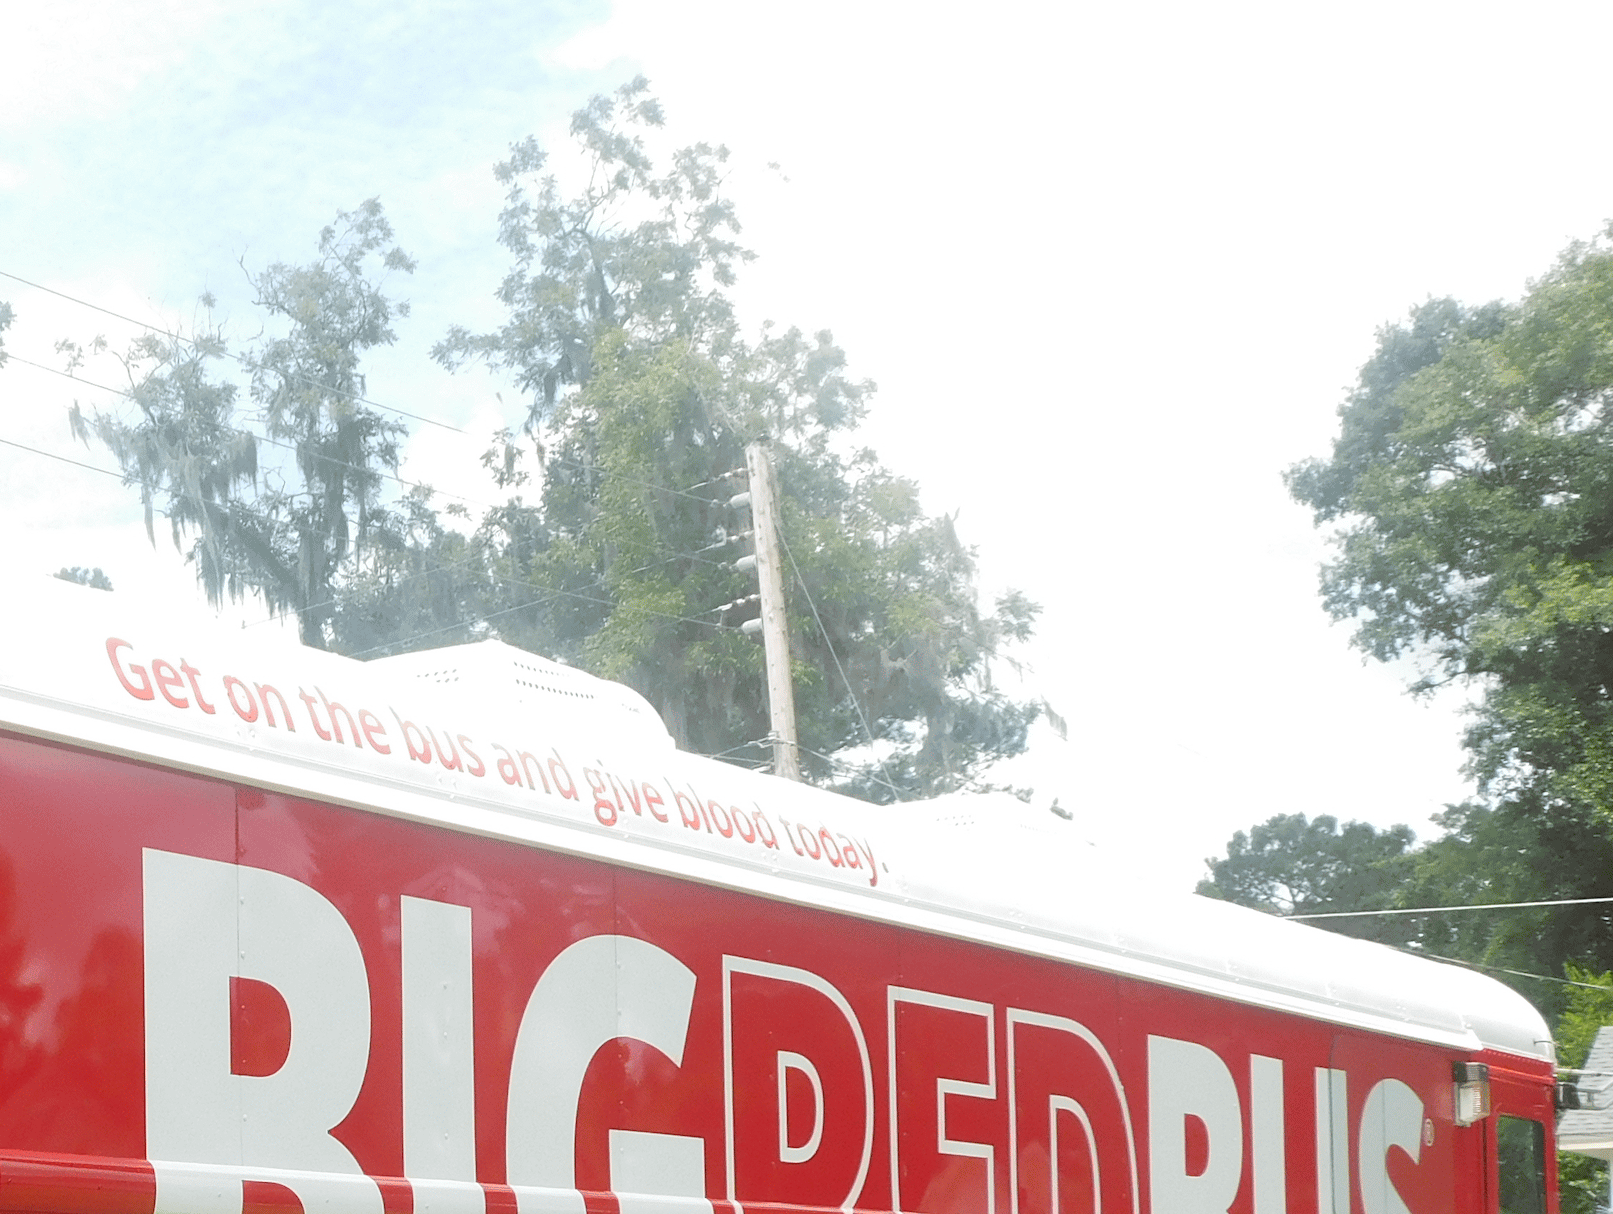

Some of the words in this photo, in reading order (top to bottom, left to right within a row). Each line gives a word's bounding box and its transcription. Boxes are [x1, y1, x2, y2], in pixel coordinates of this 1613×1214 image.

[105, 636, 216, 715] Get
[223, 674, 296, 733] on
[298, 684, 392, 755] the
[388, 705, 486, 778] bus
[491, 743, 580, 802] and
[582, 758, 669, 827] give
[663, 776, 780, 850] blood
[778, 814, 889, 887] today.
